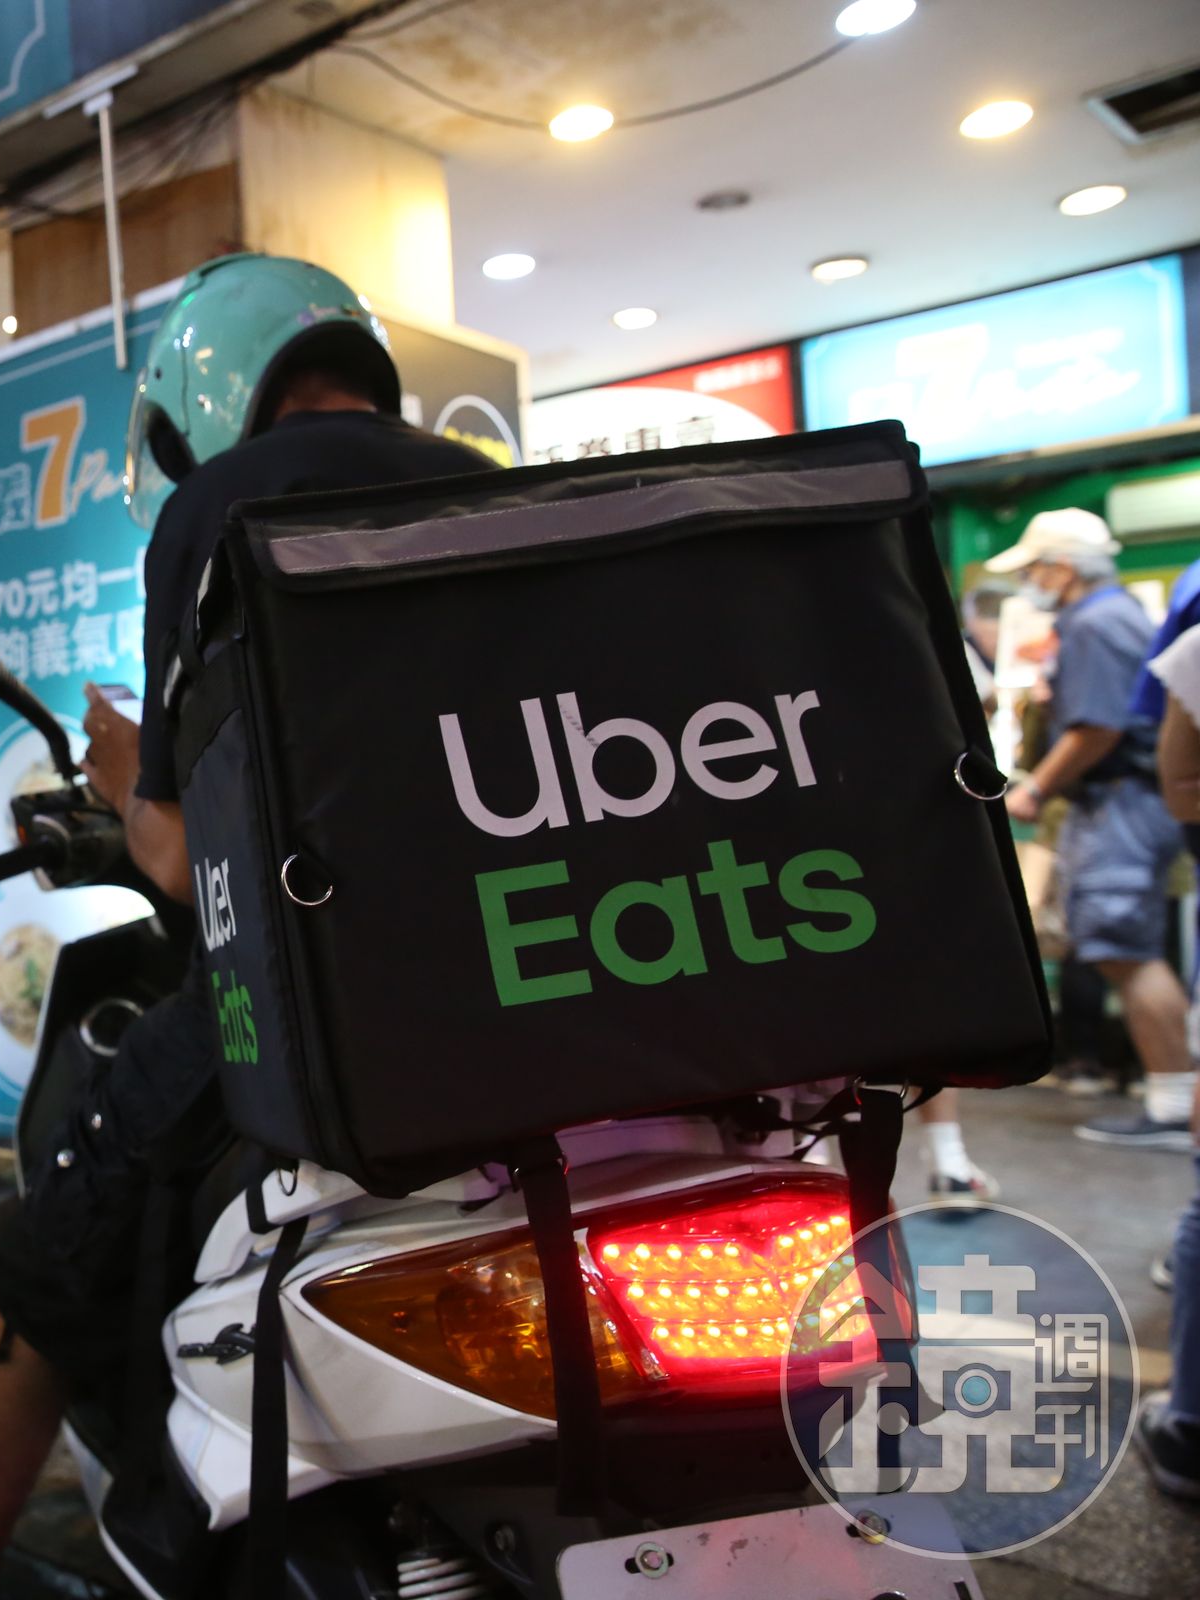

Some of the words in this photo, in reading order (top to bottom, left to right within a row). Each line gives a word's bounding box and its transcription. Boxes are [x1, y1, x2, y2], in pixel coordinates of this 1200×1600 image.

[21, 395, 87, 529] 7
[439, 690, 820, 837] Uber
[475, 839, 877, 1007] Eats
[212, 970, 259, 1064] Eats
